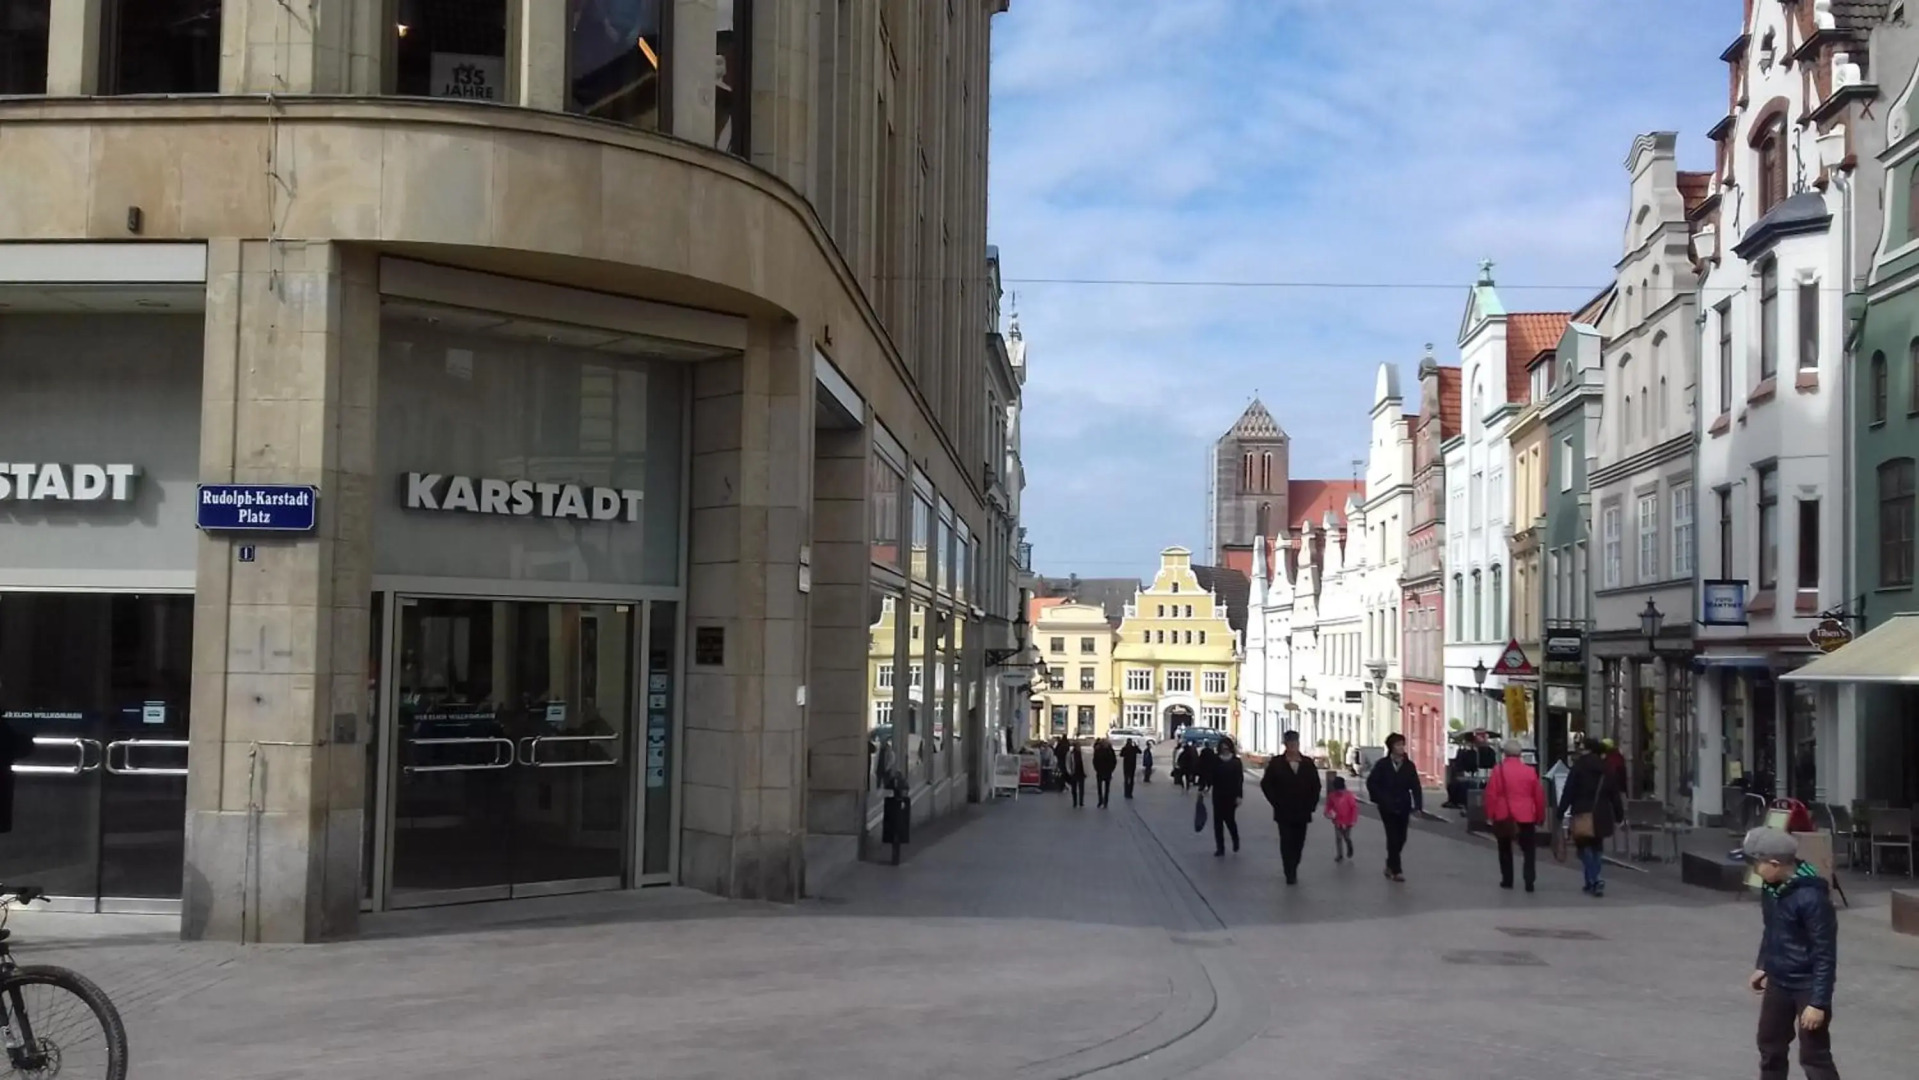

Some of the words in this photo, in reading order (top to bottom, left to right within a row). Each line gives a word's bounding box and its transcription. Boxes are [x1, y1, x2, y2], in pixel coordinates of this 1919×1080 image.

[453, 67, 485, 85] 135
[441, 83, 494, 98] JAHRE
[202, 489, 310, 508] Rudolph-Karstadt
[408, 471, 645, 522] KARSTADT
[238, 508, 272, 523] Platz
